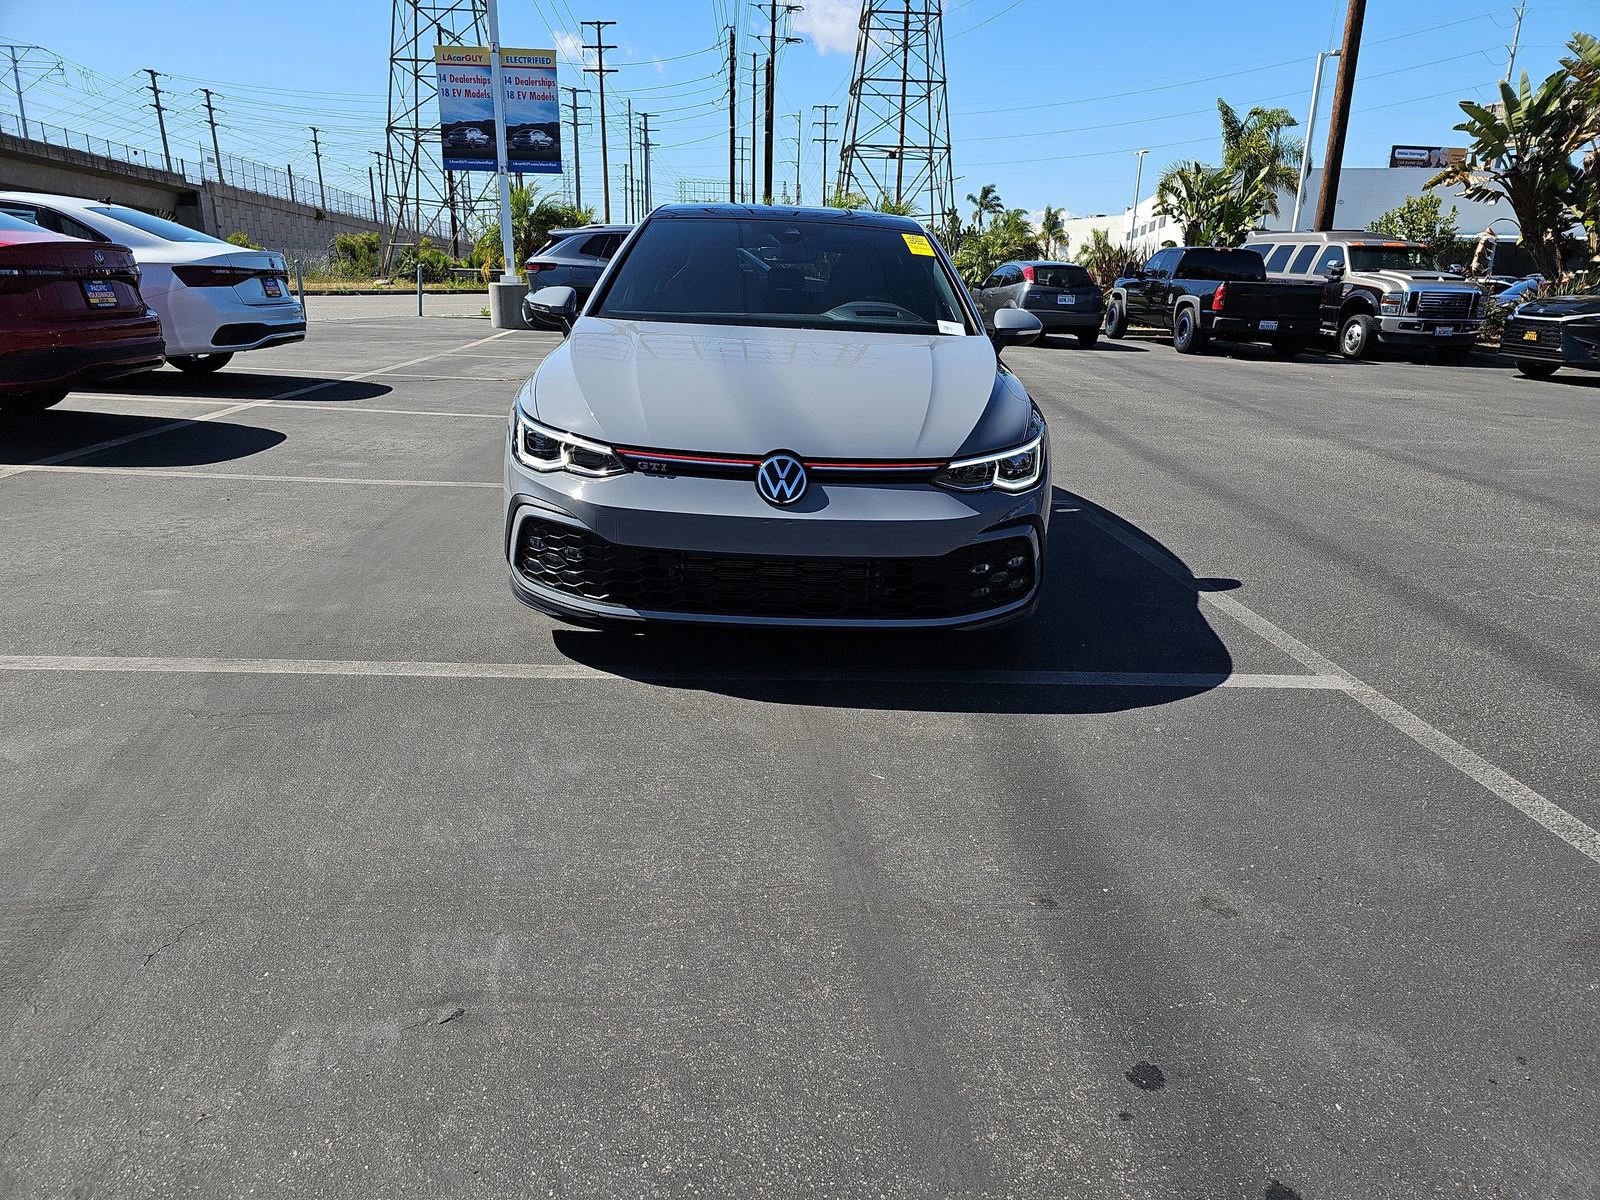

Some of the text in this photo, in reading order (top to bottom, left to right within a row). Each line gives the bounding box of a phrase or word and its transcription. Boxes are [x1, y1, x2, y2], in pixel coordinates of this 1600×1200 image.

[442, 54, 483, 62] LAcarGUY
[505, 56, 552, 65] ELECTRIFIED
[438, 74, 491, 87] 14 Dealerships
[504, 76, 556, 90] 14 Dealerships
[441, 88, 490, 99] 18 EV Models
[506, 90, 556, 102] 18 EV Models
[638, 462, 667, 471] GTI
[759, 456, 806, 501] VW
